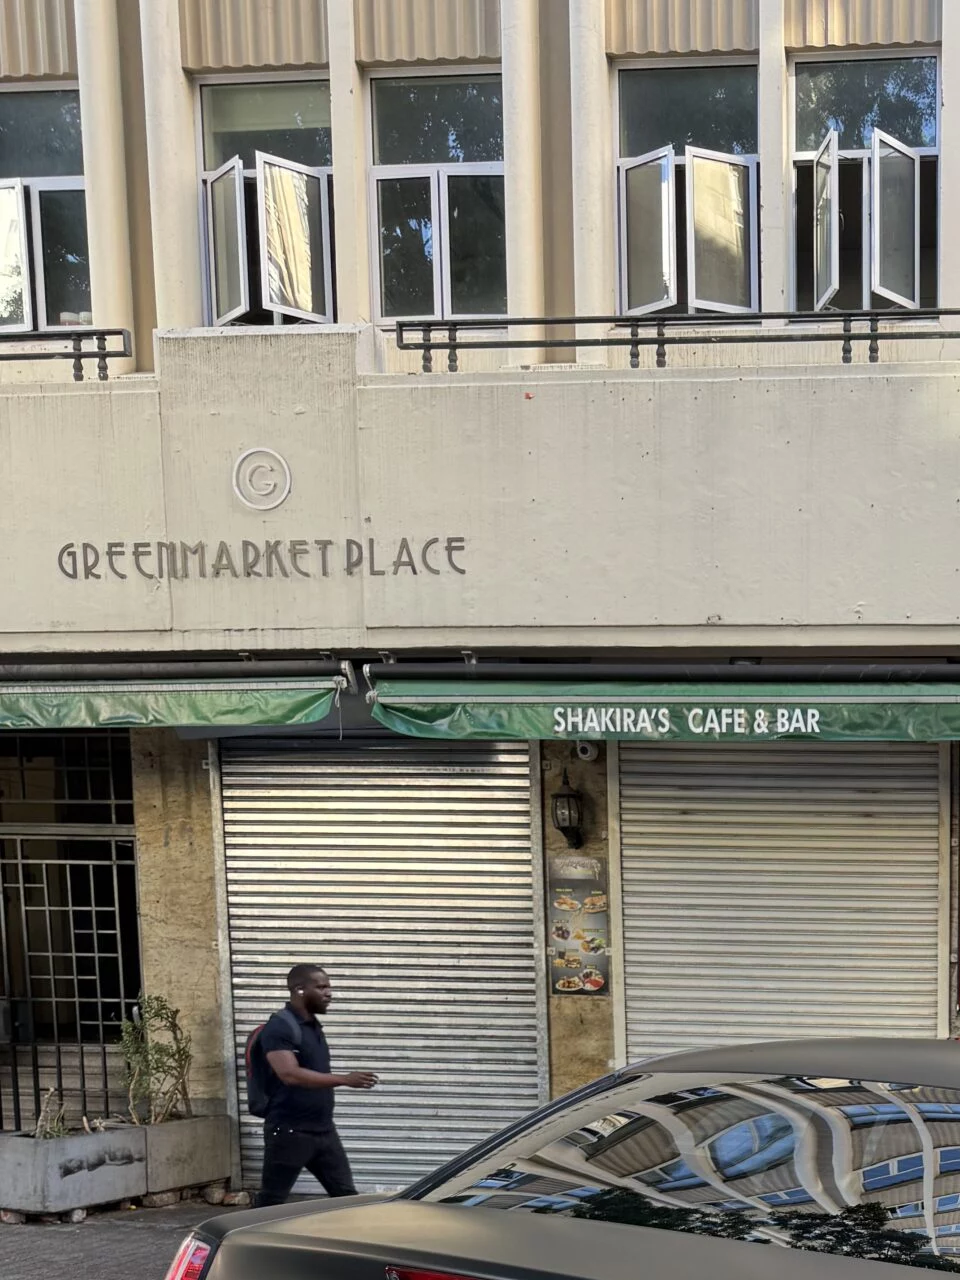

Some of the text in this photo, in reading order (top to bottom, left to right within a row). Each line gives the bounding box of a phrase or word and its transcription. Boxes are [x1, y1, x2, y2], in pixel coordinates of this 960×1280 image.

[57, 537, 467, 580] GREENMARKET PLACE
[553, 707, 821, 734] SHAKIRA'S CAFE & BAR
